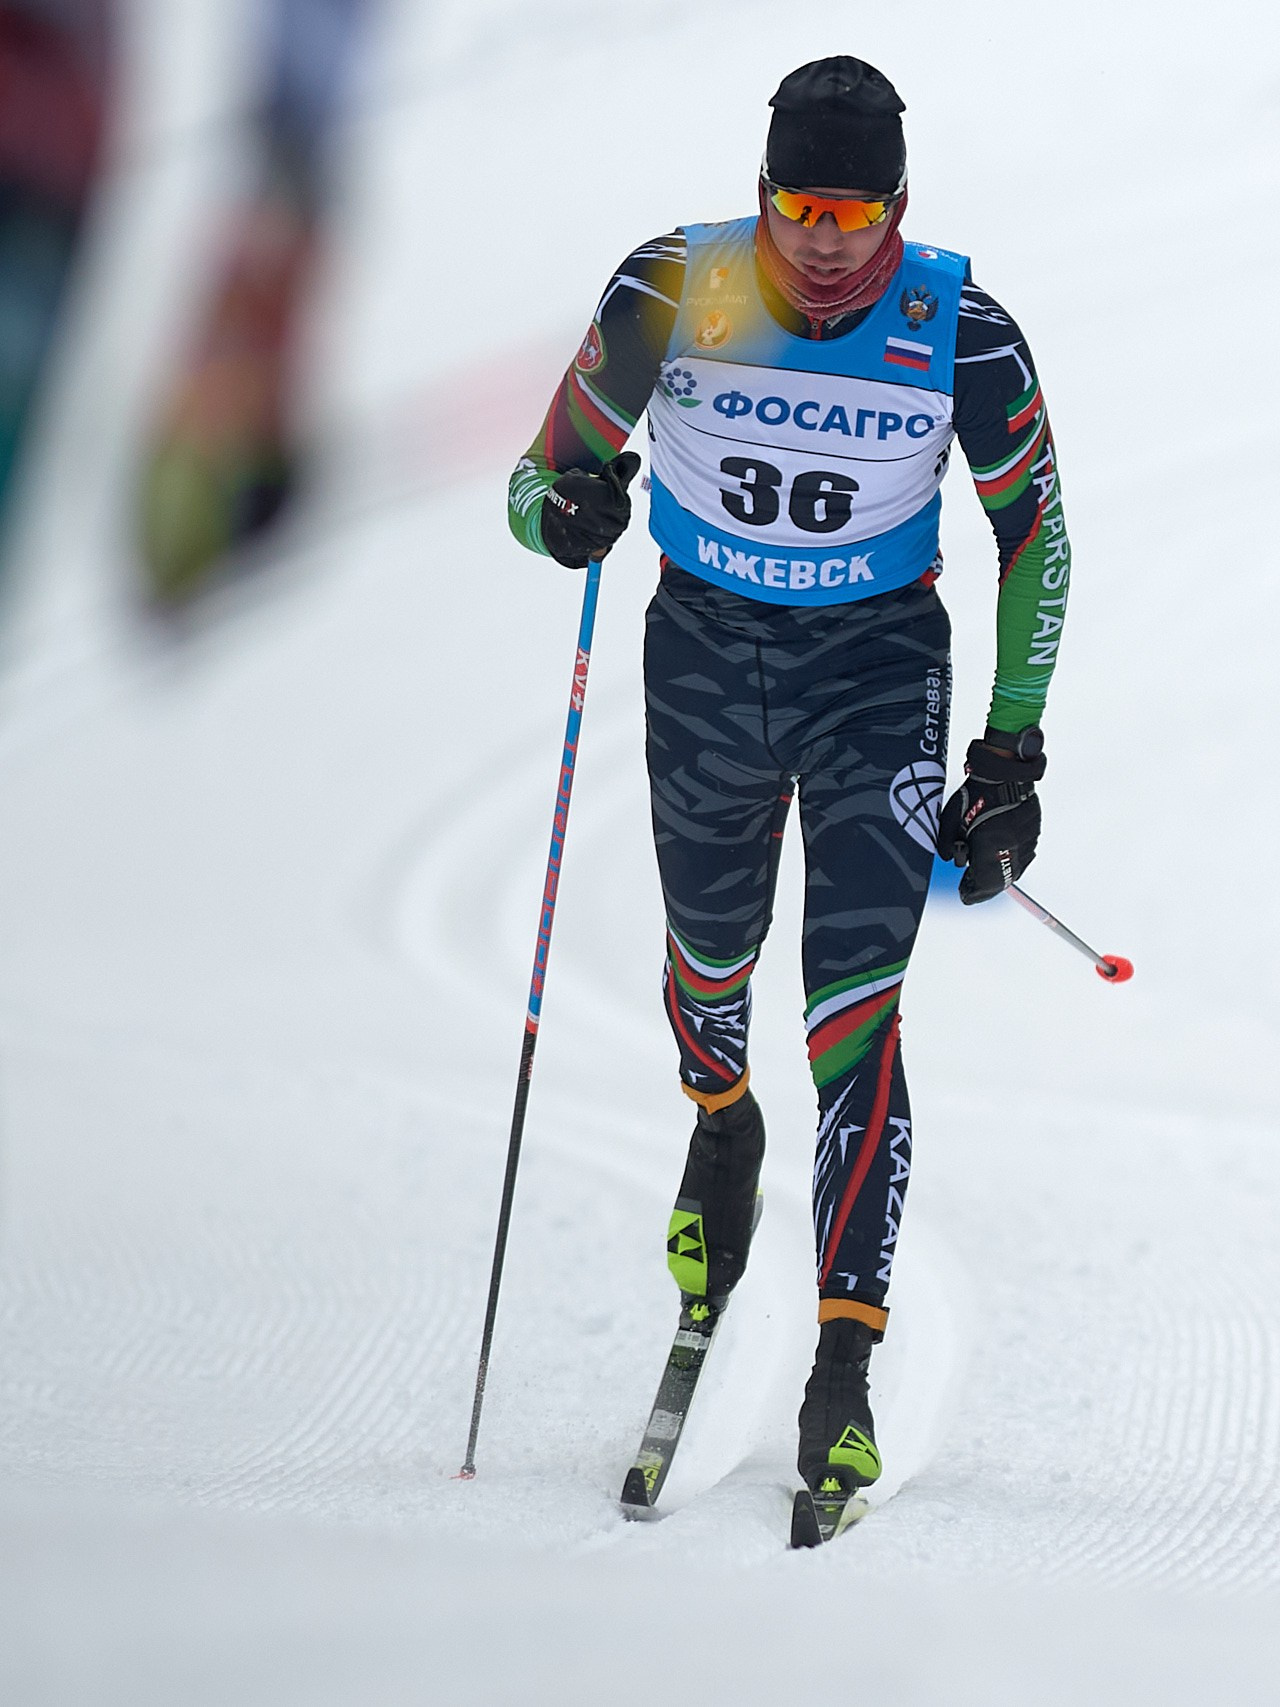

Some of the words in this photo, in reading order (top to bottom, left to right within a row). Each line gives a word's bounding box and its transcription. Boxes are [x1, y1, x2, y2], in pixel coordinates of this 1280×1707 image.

[712, 390, 936, 442] ФОСАГРО
[718, 456, 860, 534] 36
[697, 534, 876, 590] ИЖЕВСК
[1027, 443, 1069, 666] TATARSTAN
[874, 1115, 912, 1284] KAZAN
